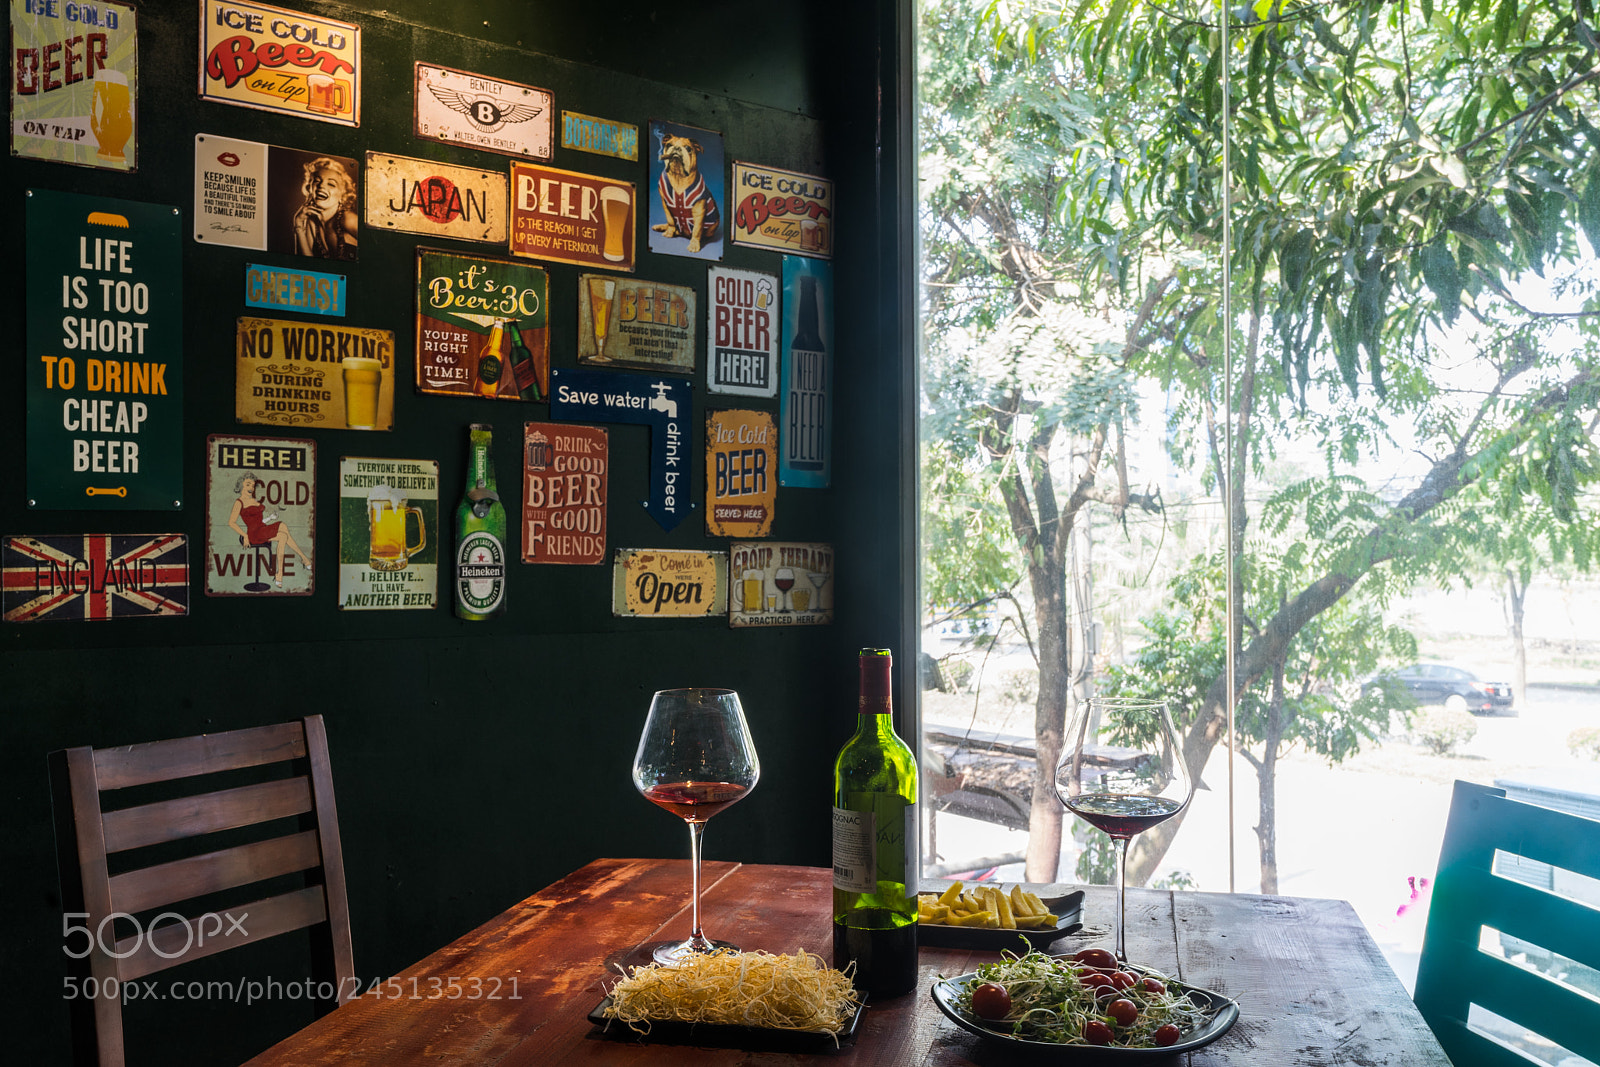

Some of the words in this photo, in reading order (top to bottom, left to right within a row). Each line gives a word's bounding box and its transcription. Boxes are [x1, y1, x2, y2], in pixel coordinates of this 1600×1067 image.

[26, 0, 59, 18] ICE
[65, 1, 118, 30] COLD
[215, 5, 264, 34] ICE
[271, 18, 346, 50] COLD
[16, 33, 108, 95] BEER
[207, 35, 355, 89] Beer
[251, 79, 275, 91] on
[276, 73, 306, 102] Tap
[470, 78, 503, 94] BENTLEY
[477, 103, 494, 123] B
[23, 121, 48, 136] ON
[52, 125, 86, 141] TAP
[420, 123, 429, 133] 18
[565, 116, 618, 153] BOTTOMS
[622, 127, 636, 156] UP
[477, 135, 491, 145] OWEN
[493, 139, 516, 150] BENTLEY
[204, 171, 224, 182] KEEP
[225, 174, 256, 187] SMILING
[204, 181, 234, 192] BECAUSE
[235, 186, 248, 195] LIFE
[249, 188, 256, 196] IS
[742, 170, 772, 190] ICE
[777, 177, 826, 200] COLD
[209, 191, 238, 201] BEAUTIFUL
[240, 195, 256, 204] THING
[390, 178, 486, 224] JAPAN
[518, 174, 599, 223] BEER
[204, 205, 212, 213] TO
[213, 206, 233, 216] SMILE
[234, 209, 256, 219] ABOUT
[736, 192, 831, 235] Beer
[516, 231, 526, 243] UP
[527, 233, 552, 248] EVERY
[518, 217, 525, 227] IS
[527, 218, 542, 232] THE
[543, 221, 574, 235] REASON
[581, 227, 597, 239] GET
[763, 224, 781, 234] on
[779, 221, 800, 243] Tap
[80, 235, 133, 274] LIFE
[247, 269, 338, 311] CHEERS!
[458, 264, 499, 292] it's
[63, 275, 88, 310] IS
[98, 278, 149, 315] TOO
[428, 276, 539, 316] Beer:30
[715, 276, 753, 308] COLD
[619, 286, 689, 329] BEER
[62, 316, 149, 354] SHORT
[424, 329, 468, 342] YOU'RE
[619, 322, 649, 335] because
[650, 328, 664, 337] your
[664, 328, 688, 339] friends
[715, 305, 770, 351] BEER
[240, 328, 273, 359] NO
[282, 327, 390, 369] WORKING
[424, 341, 468, 354] RIGHT
[664, 339, 678, 349] that
[424, 365, 469, 379] TIME!
[436, 354, 458, 364] on
[720, 352, 764, 385] HERE!
[797, 352, 818, 391] NEED
[41, 355, 75, 390] TO
[87, 358, 168, 395] DRINK
[261, 373, 323, 387] DURING
[252, 386, 331, 401] DRINKING
[264, 400, 319, 413] HOURS
[558, 385, 599, 405] Save
[603, 391, 646, 409] water
[63, 398, 148, 433] CHEAP
[789, 392, 825, 461] BEER
[555, 435, 592, 453] DRINK
[666, 422, 681, 467] drink
[716, 423, 735, 444] Ice
[738, 424, 767, 444] Cold
[73, 439, 139, 473] BEER
[222, 447, 301, 469] HERE!
[357, 462, 395, 473] EVERYONE
[477, 450, 485, 480] Heineke
[554, 455, 605, 475] GOOD
[343, 474, 385, 488] SOMETHING
[387, 476, 395, 489] TO
[398, 476, 426, 489] BELIEVE
[428, 477, 436, 490] IN
[715, 448, 768, 499] BEER
[252, 479, 310, 506] COLD
[527, 473, 604, 508] BEER
[665, 472, 680, 513] beer
[526, 510, 547, 520] WITH
[550, 507, 601, 535] GOOD
[715, 509, 741, 518] SERVED
[743, 509, 762, 519] HERE
[527, 520, 603, 557] FRIENDS
[35, 558, 157, 595] ENGLAND
[213, 553, 295, 577] WINE
[461, 566, 500, 577] Heineken
[660, 555, 692, 571] Come
[693, 555, 704, 568] in
[733, 547, 772, 579] GROUP
[780, 547, 832, 573] THERAPY
[345, 594, 400, 607] ANOTHER
[403, 593, 432, 606] BEER
[372, 583, 384, 592] I'LL
[635, 572, 702, 613] Open
[749, 616, 792, 625] PRACTICED
[796, 615, 815, 624] HERE
